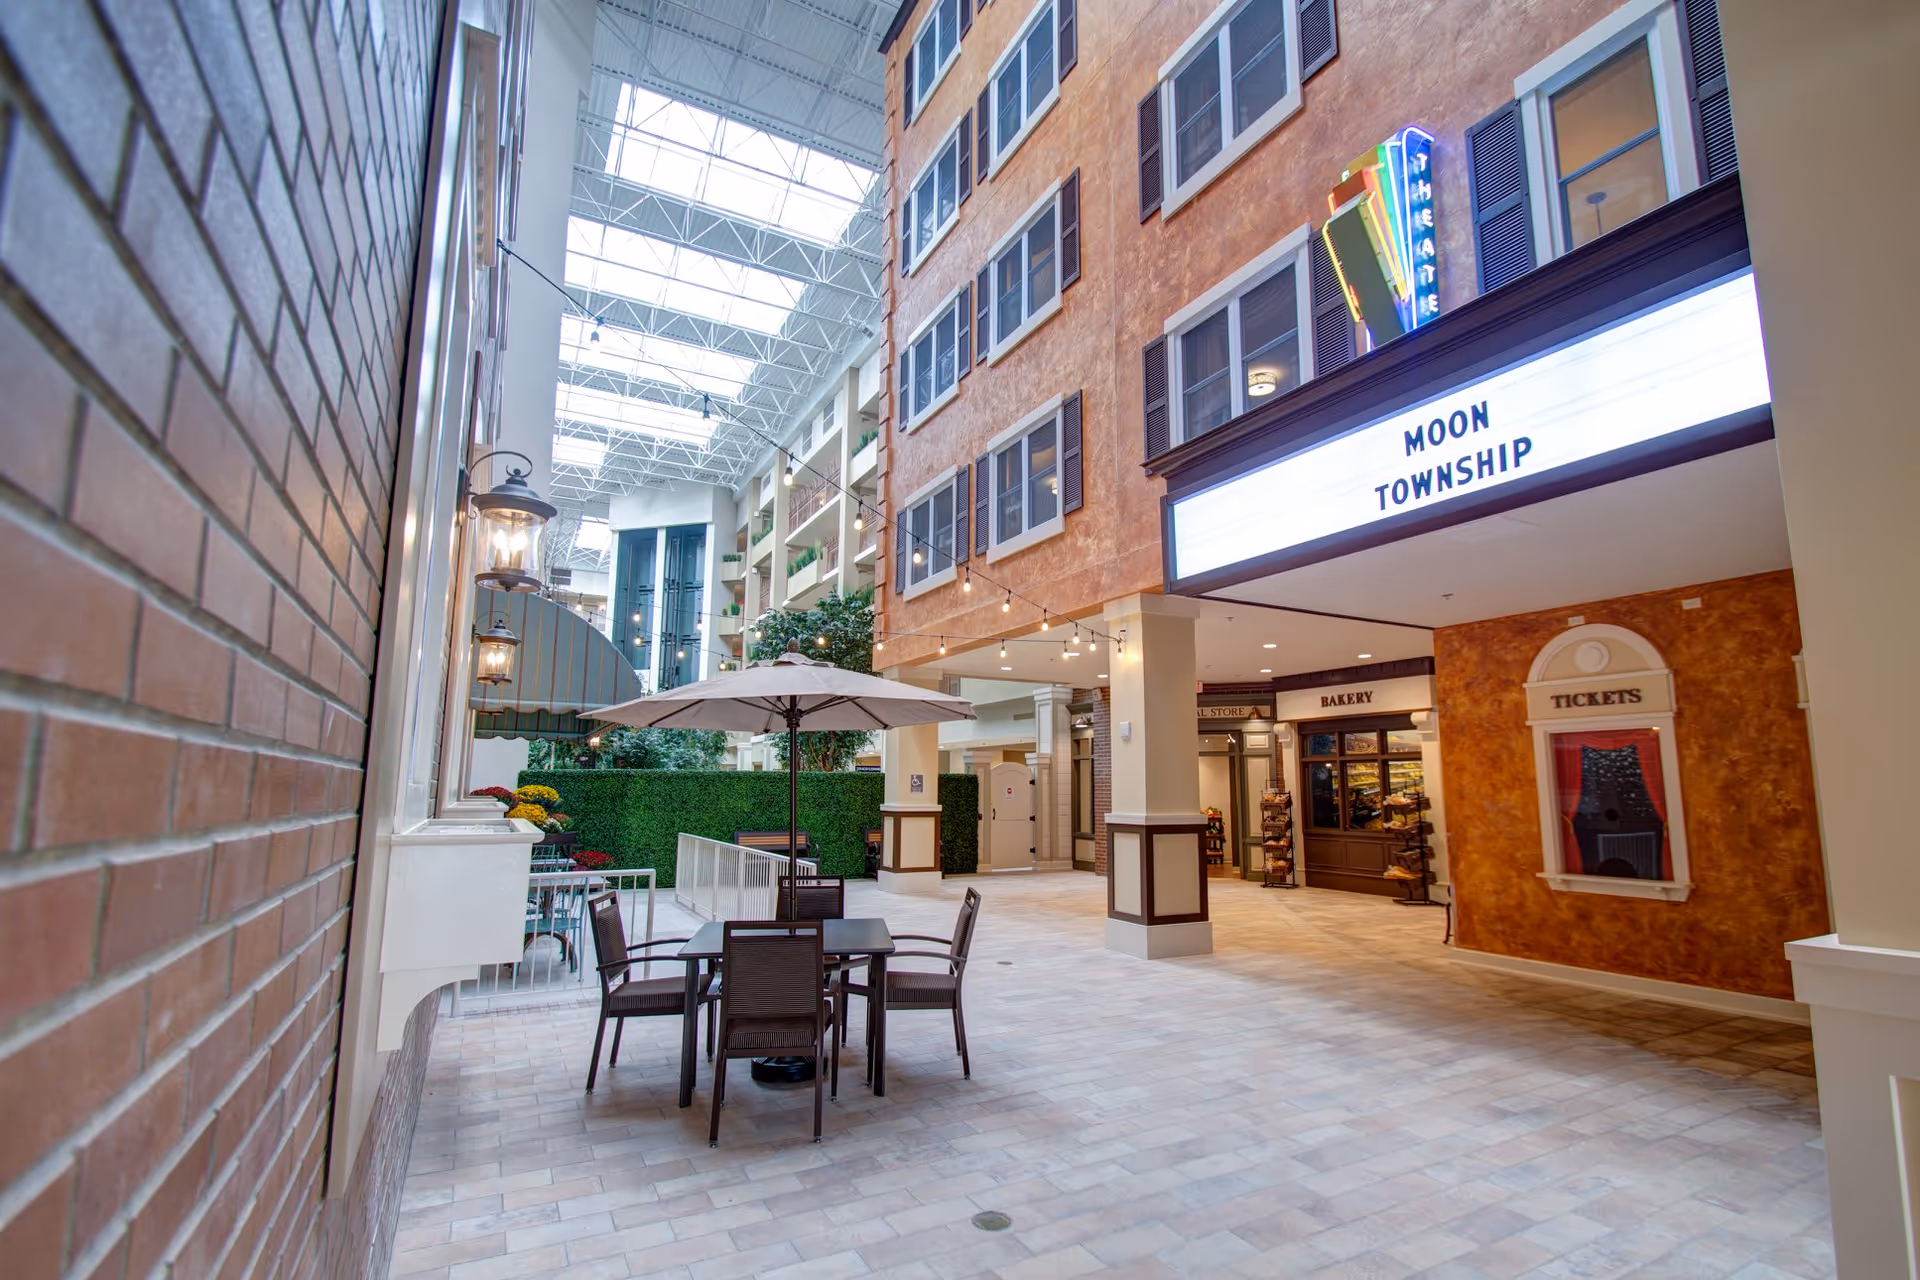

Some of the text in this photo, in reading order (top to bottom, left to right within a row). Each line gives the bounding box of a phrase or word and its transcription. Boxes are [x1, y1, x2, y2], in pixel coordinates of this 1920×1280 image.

[1404, 401, 1489, 457] MOON
[1374, 437, 1532, 511] TOWNSHIP
[1321, 690, 1373, 707] BAKERY
[1550, 688, 1642, 708] TICKETS
[1210, 707, 1245, 717] STORE
